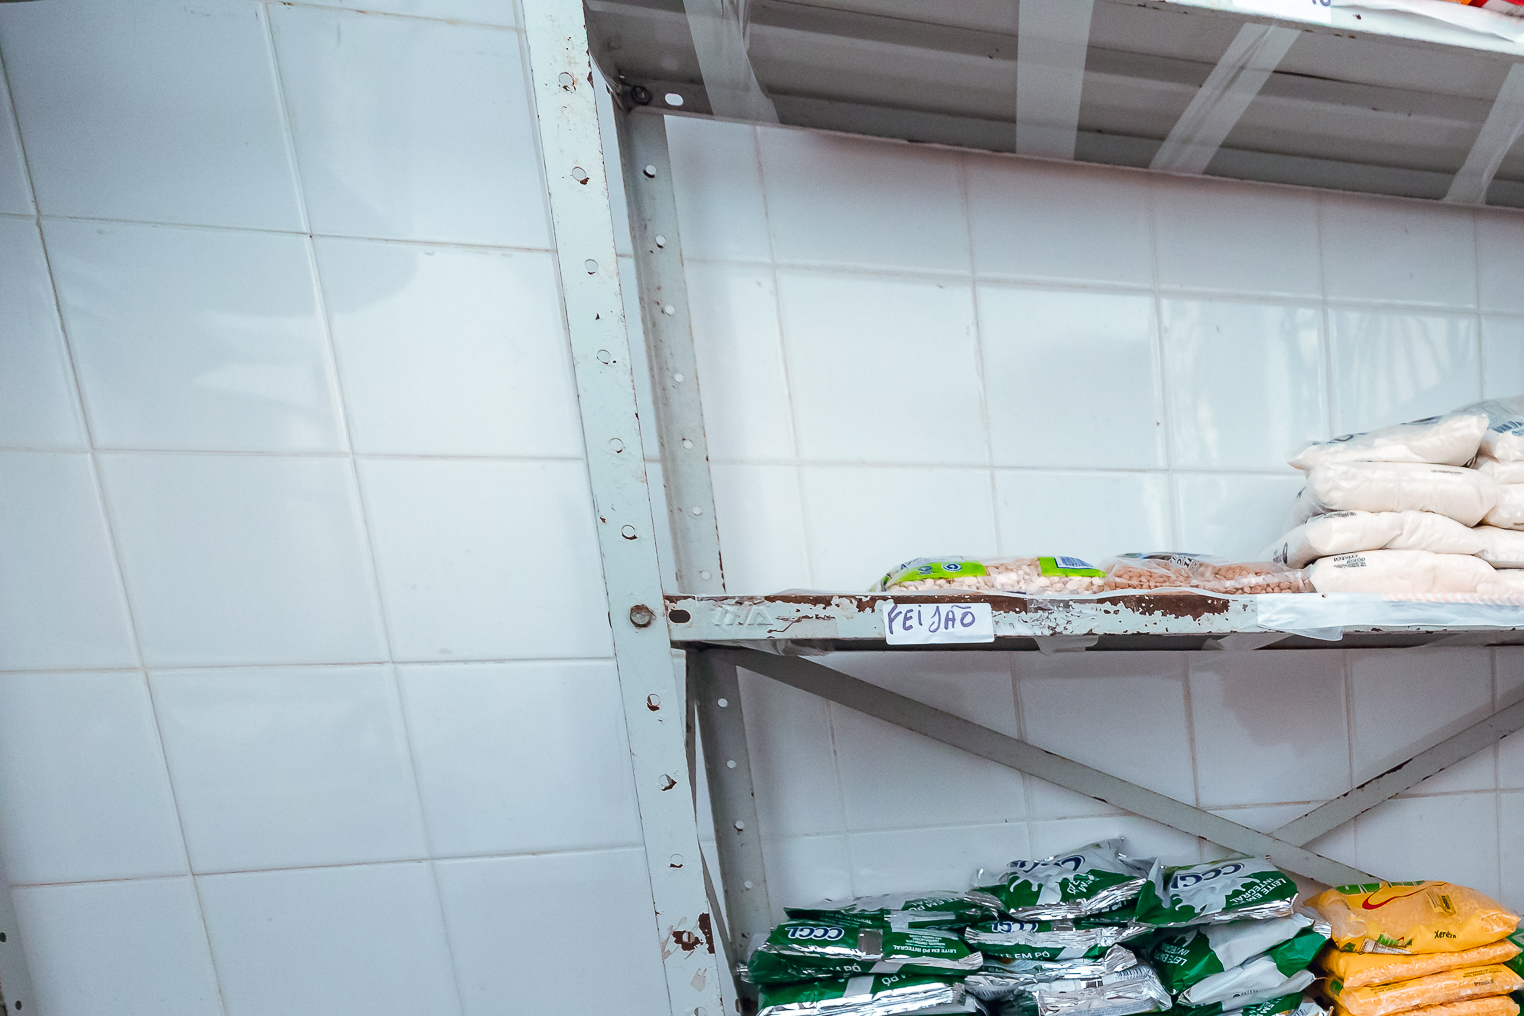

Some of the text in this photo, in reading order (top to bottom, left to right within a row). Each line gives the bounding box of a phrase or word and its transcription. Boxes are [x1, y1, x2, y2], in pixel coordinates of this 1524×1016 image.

[1261, 877, 1287, 895] LEITE
[785, 926, 845, 941] CCGL
[892, 944, 922, 953] INTEGRAL
[1035, 949, 1051, 959] PÓ
[881, 976, 899, 988] PÓ
